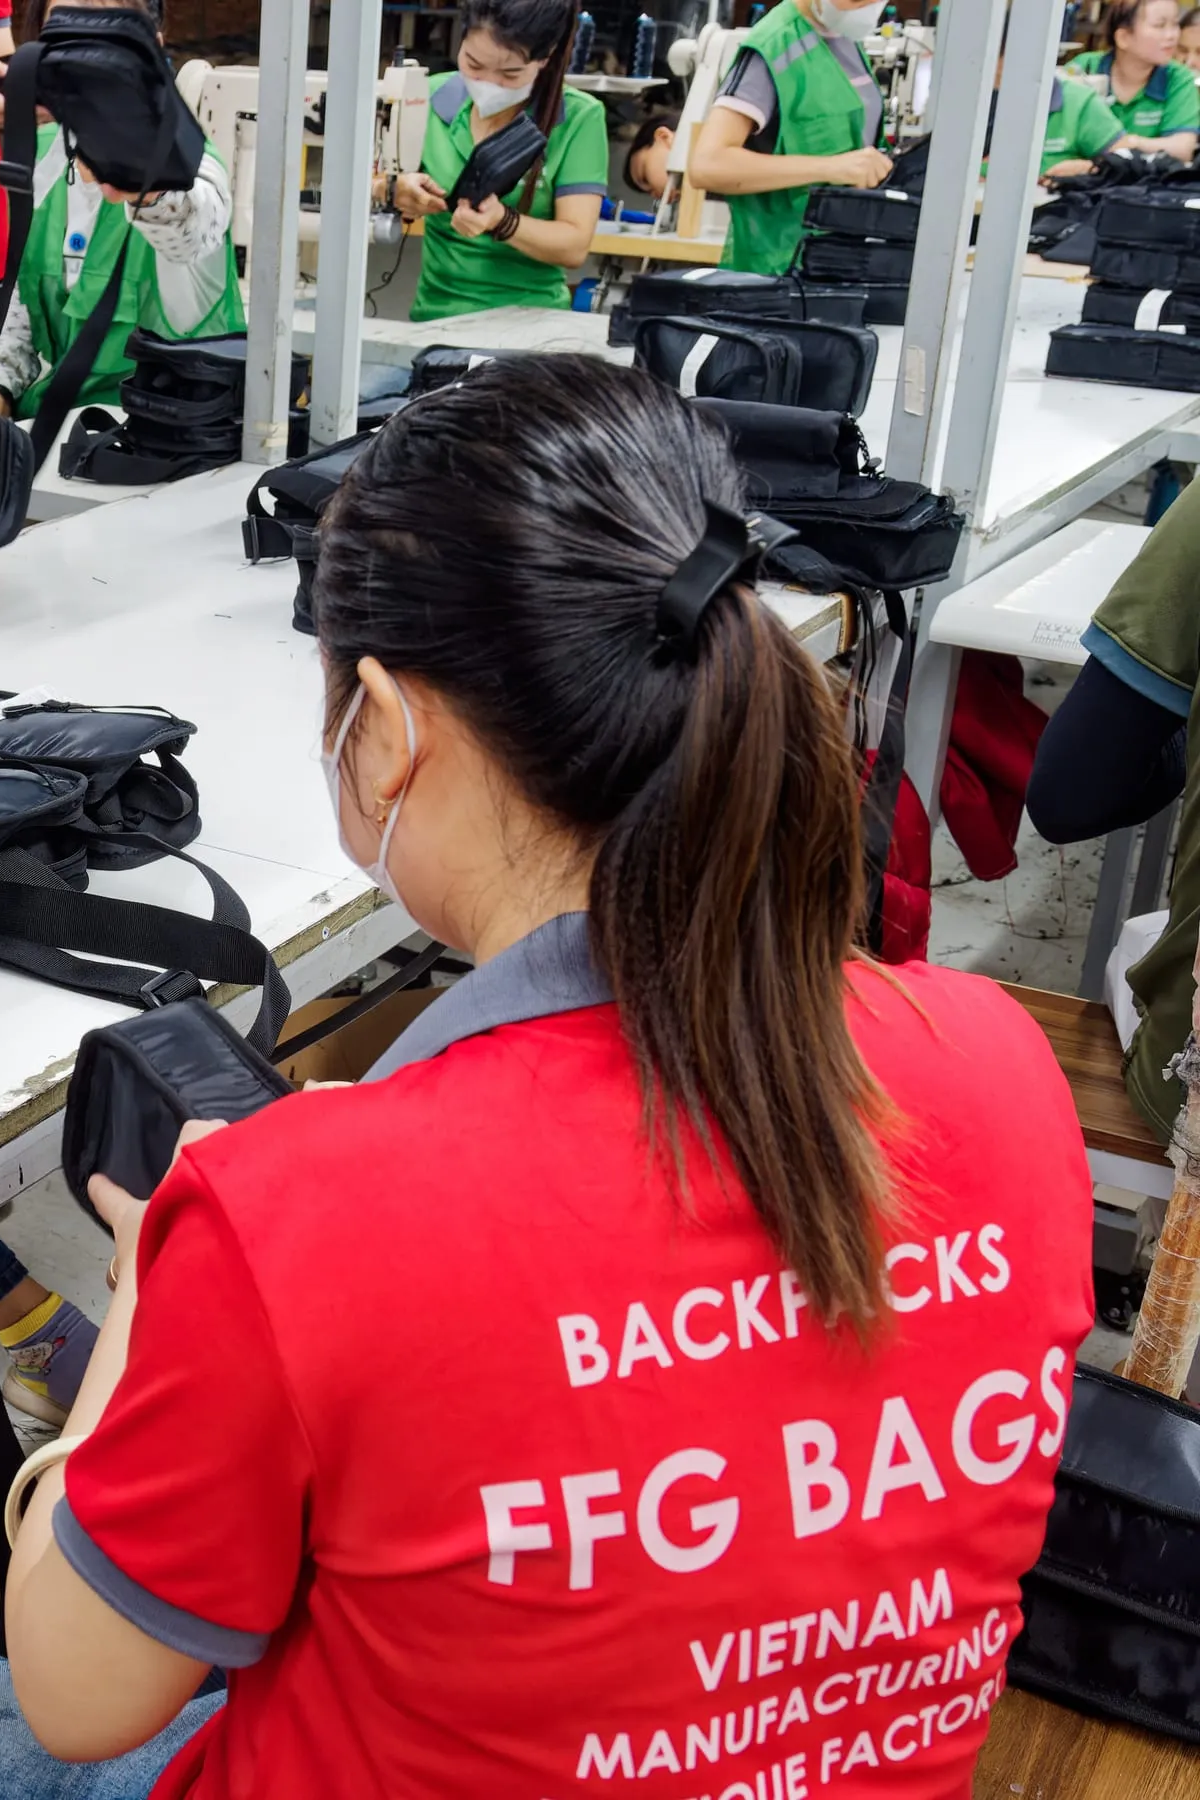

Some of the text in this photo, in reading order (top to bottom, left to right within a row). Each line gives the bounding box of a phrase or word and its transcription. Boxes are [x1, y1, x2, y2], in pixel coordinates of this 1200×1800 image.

[557, 1223, 1011, 1388] BACKPCKS
[480, 1346, 1067, 1590] FFG BAGS
[575, 1607, 1008, 1780] MANUFACTURING
[689, 1568, 954, 1692] VIETNAM
